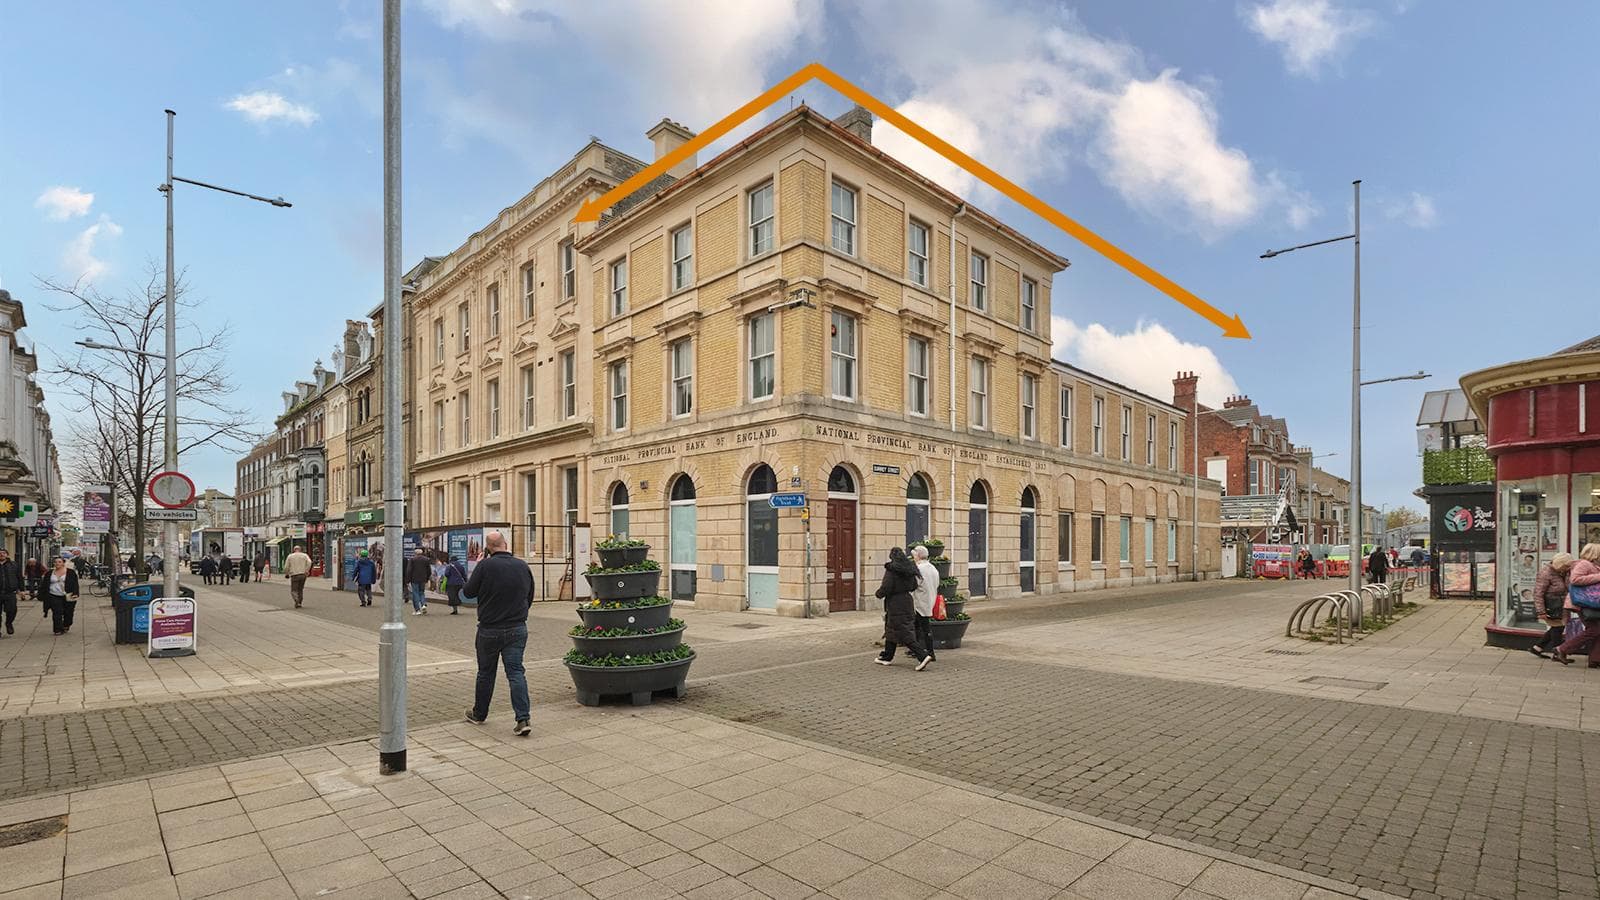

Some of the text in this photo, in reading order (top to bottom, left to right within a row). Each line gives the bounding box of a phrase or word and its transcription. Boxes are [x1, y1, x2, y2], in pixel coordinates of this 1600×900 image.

[603, 453, 630, 464] NATIONAL
[637, 445, 677, 459] PROVINCIAL
[686, 440, 706, 452] BANK
[716, 437, 726, 447] OF
[816, 424, 860, 441] NATIONAL
[866, 434, 911, 449] PROVINCIAL
[918, 442, 937, 454] BANK
[943, 447, 952, 456] OF
[1474, 510, 1493, 519] Red
